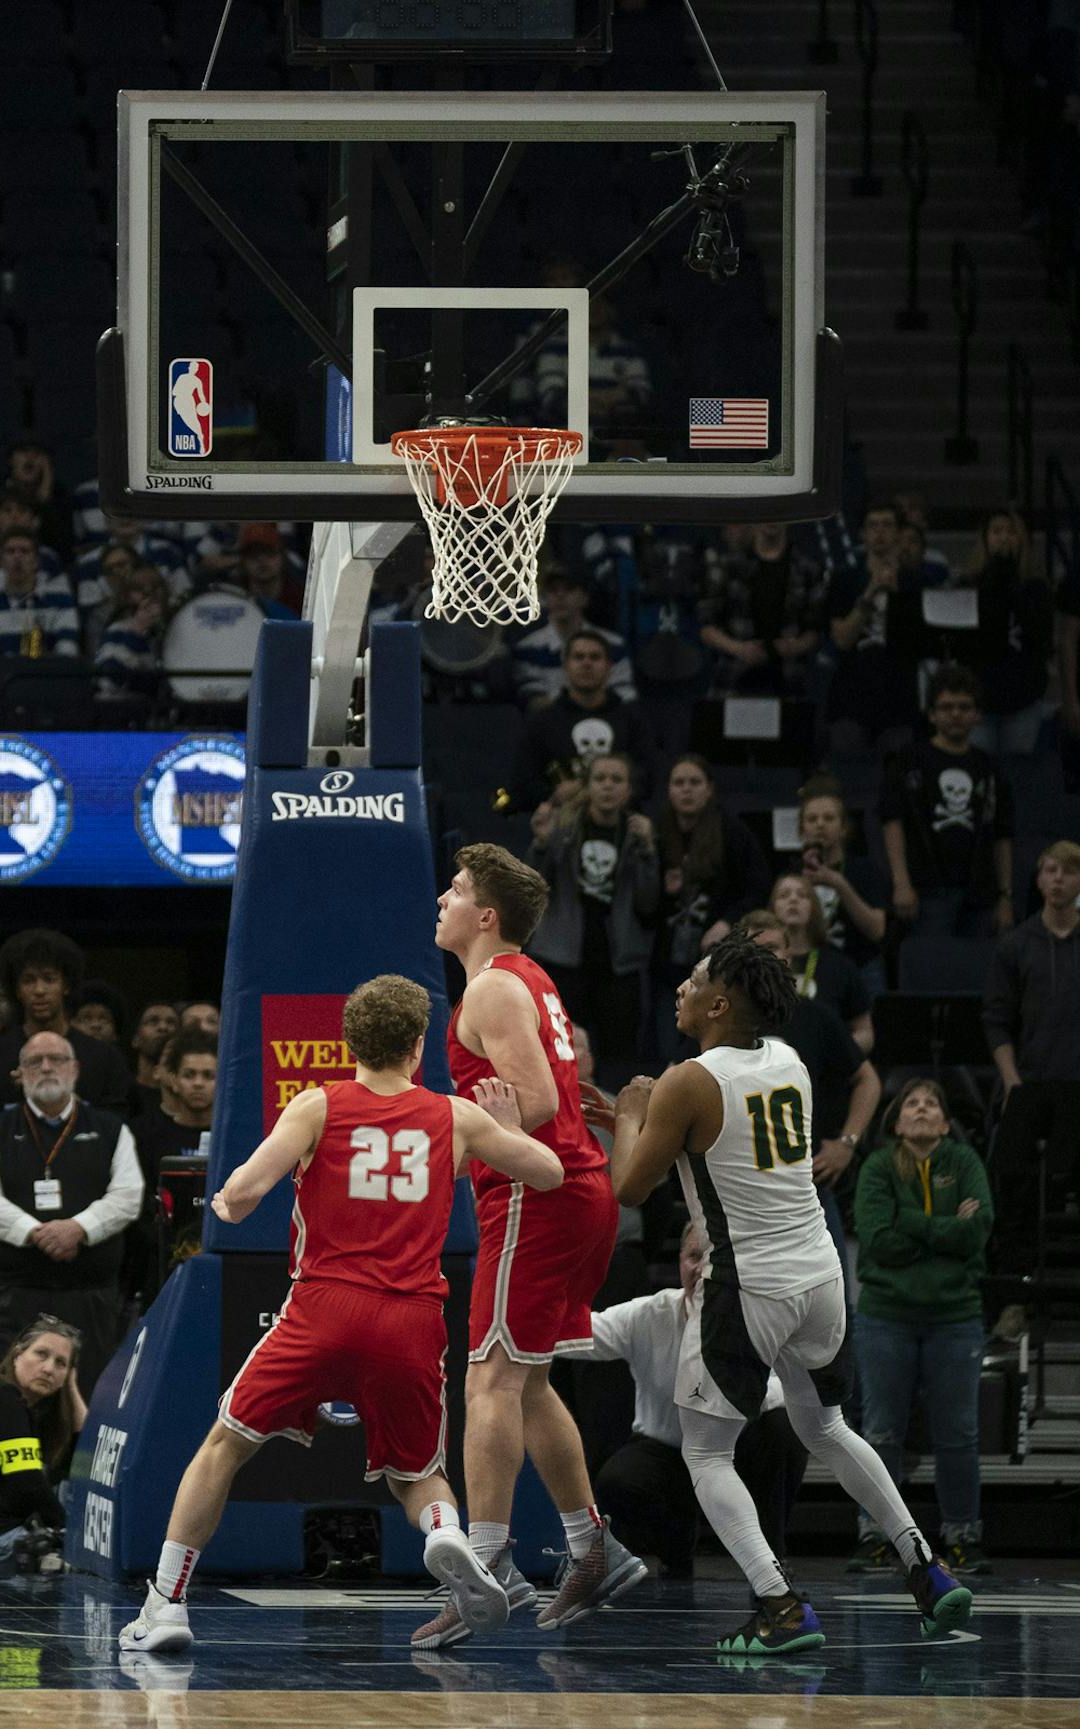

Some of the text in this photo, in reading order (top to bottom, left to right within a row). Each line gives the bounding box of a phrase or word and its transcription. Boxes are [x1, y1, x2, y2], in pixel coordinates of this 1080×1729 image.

[175, 434, 196, 451] NBA
[145, 474, 212, 493] SPALDING
[271, 790, 405, 823] SPALDING
[743, 1083, 807, 1173] 10
[348, 1125, 431, 1203] 23
